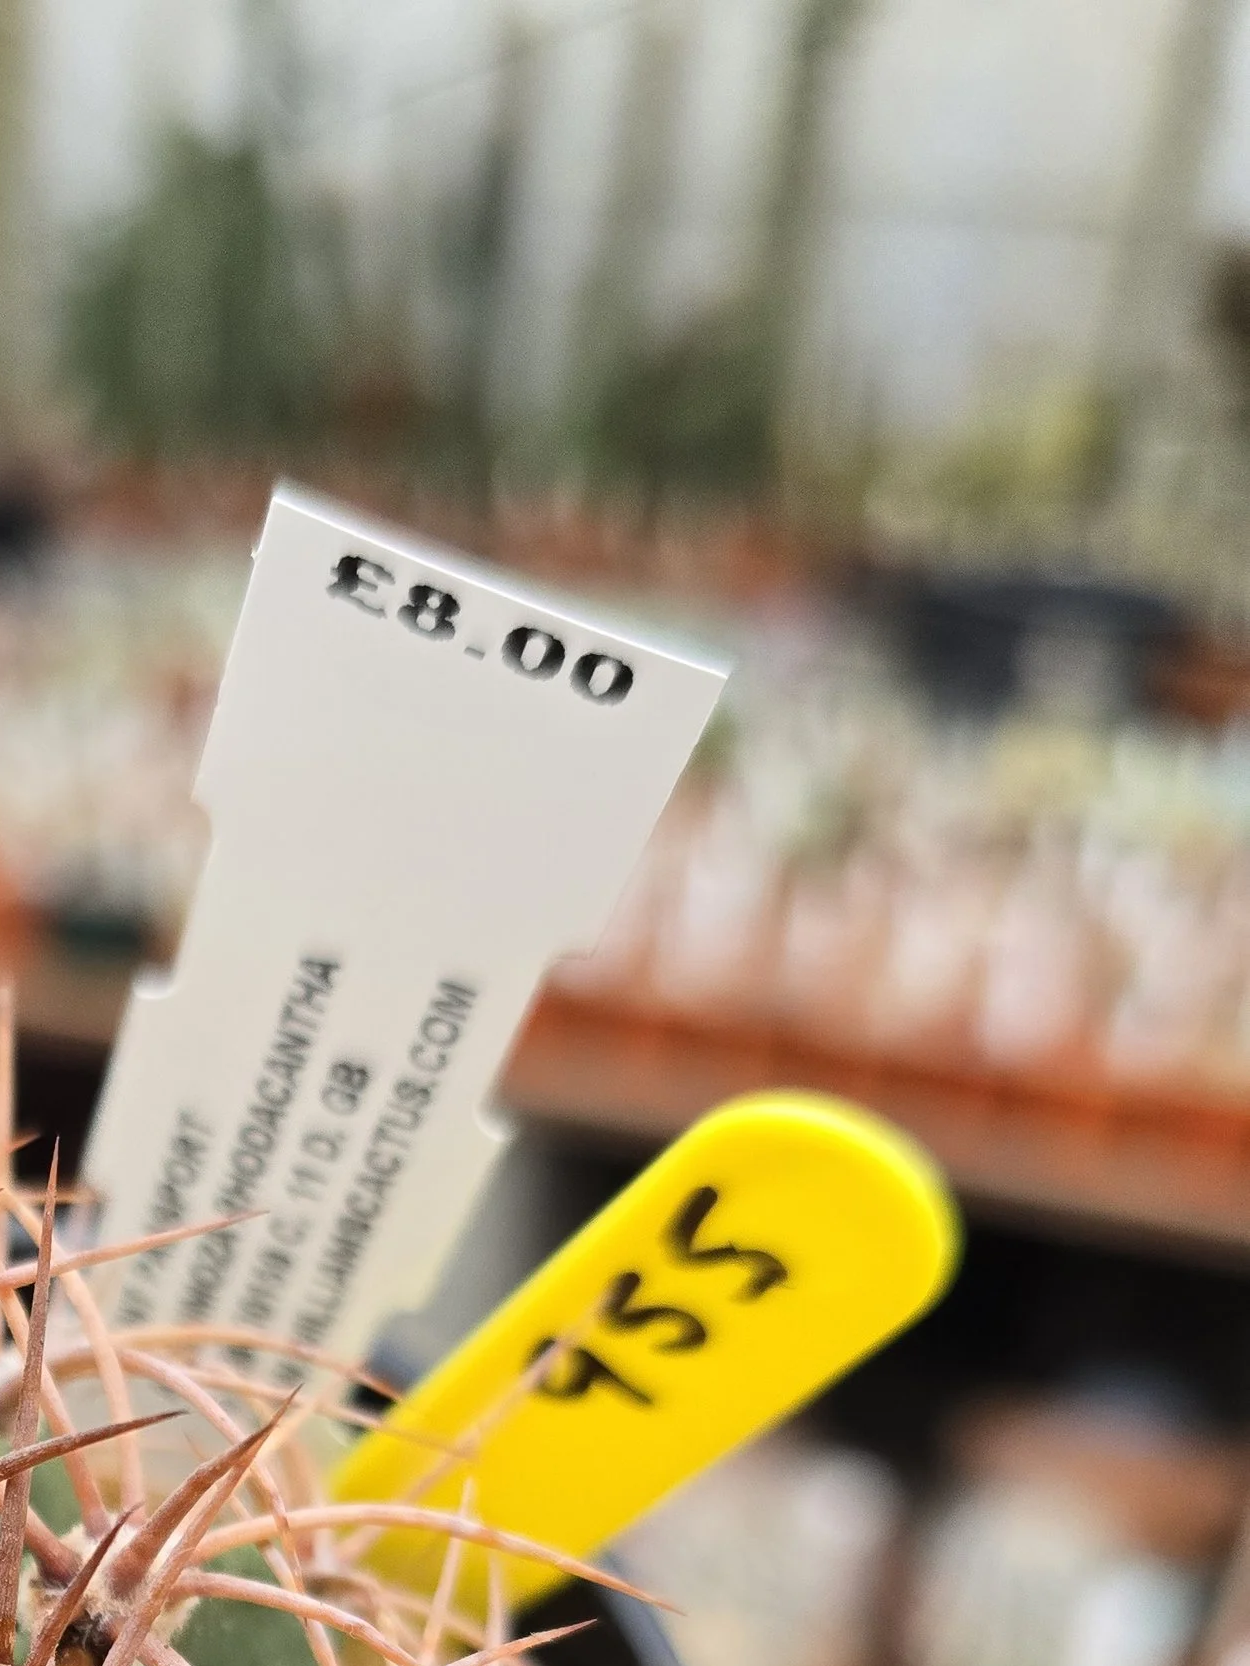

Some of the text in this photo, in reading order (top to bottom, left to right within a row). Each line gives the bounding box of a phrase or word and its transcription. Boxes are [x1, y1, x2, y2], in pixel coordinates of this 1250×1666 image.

[326, 553, 635, 707] £8.00
[320, 1060, 372, 1116] GB
[130, 1107, 214, 1281] PASPORT
[523, 1185, 788, 1407] 955
